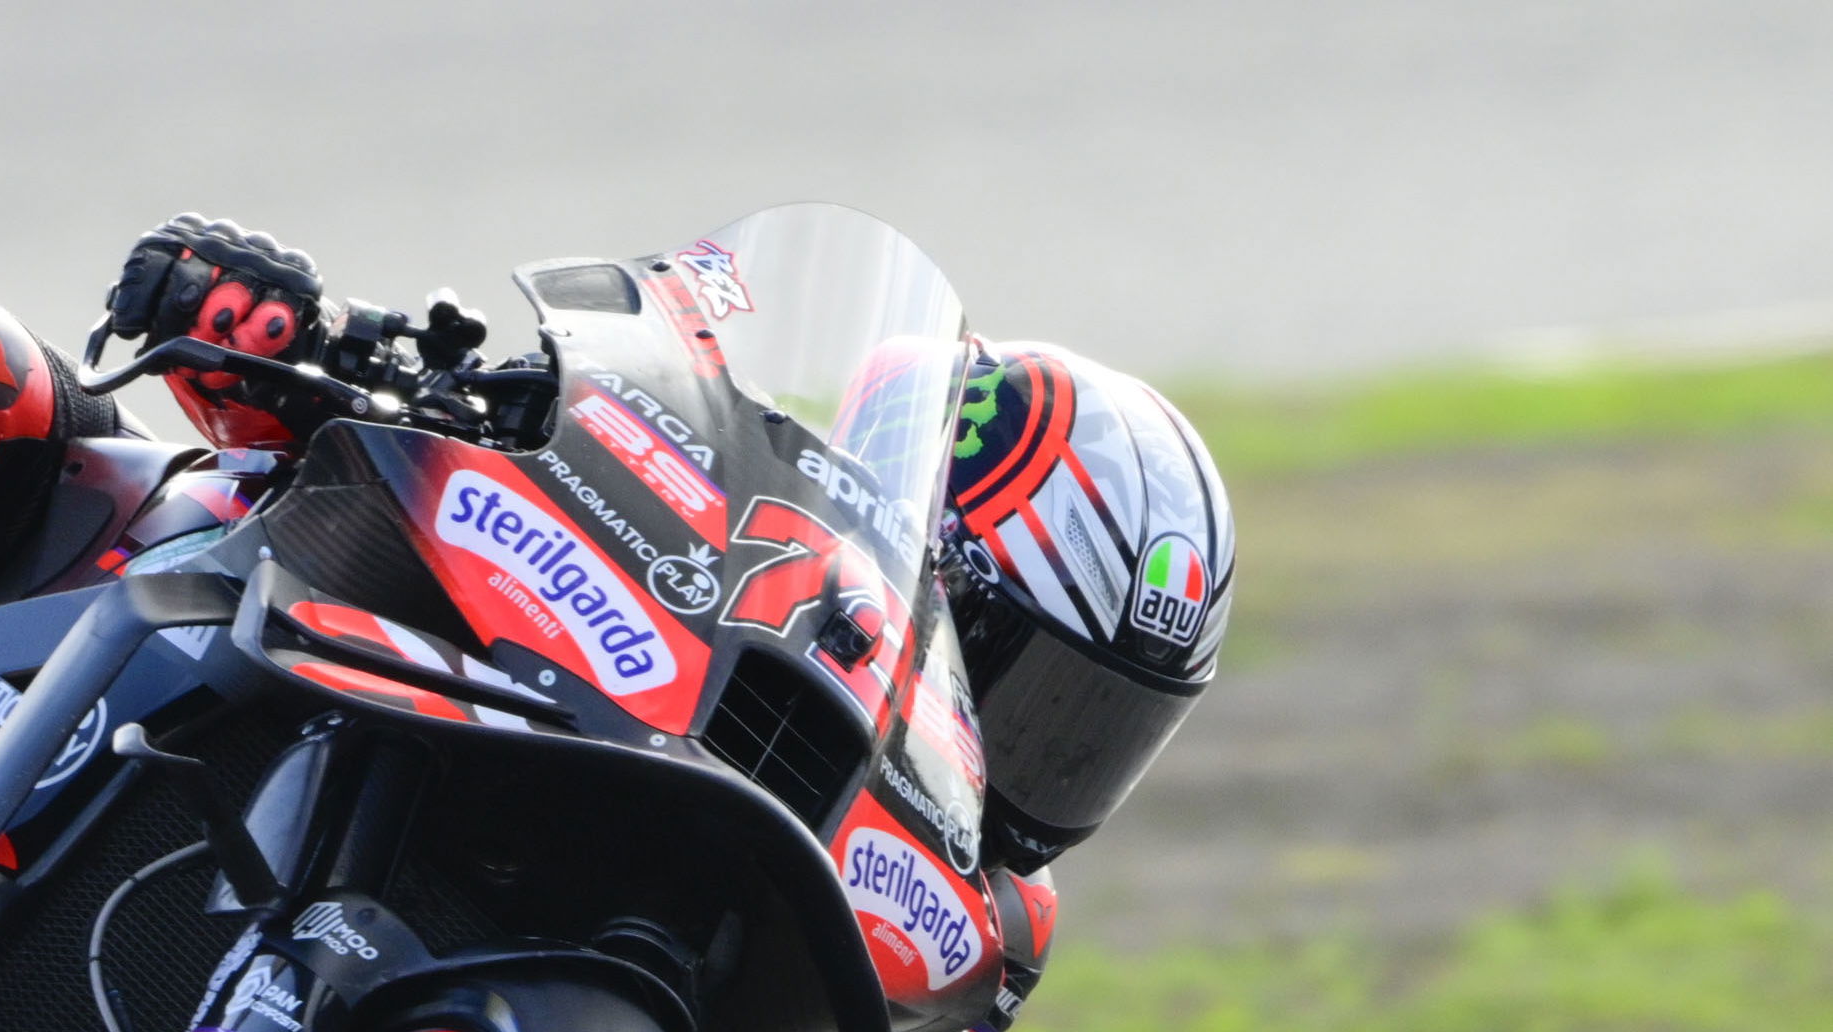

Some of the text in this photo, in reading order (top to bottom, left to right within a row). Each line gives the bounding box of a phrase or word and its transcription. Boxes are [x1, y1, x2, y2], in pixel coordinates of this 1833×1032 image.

[575, 395, 708, 512] BS
[590, 373, 714, 471] ARGA
[538, 449, 712, 607] PRAGMATIC PLAY
[796, 448, 917, 570] aprilia
[450, 486, 655, 679] sterilgarda
[487, 570, 565, 640] alimenti
[1141, 588, 1197, 636] agv
[878, 754, 946, 832] PRAGMATIC
[849, 840, 971, 976] sterilgarda
[871, 921, 919, 967] alimenti
